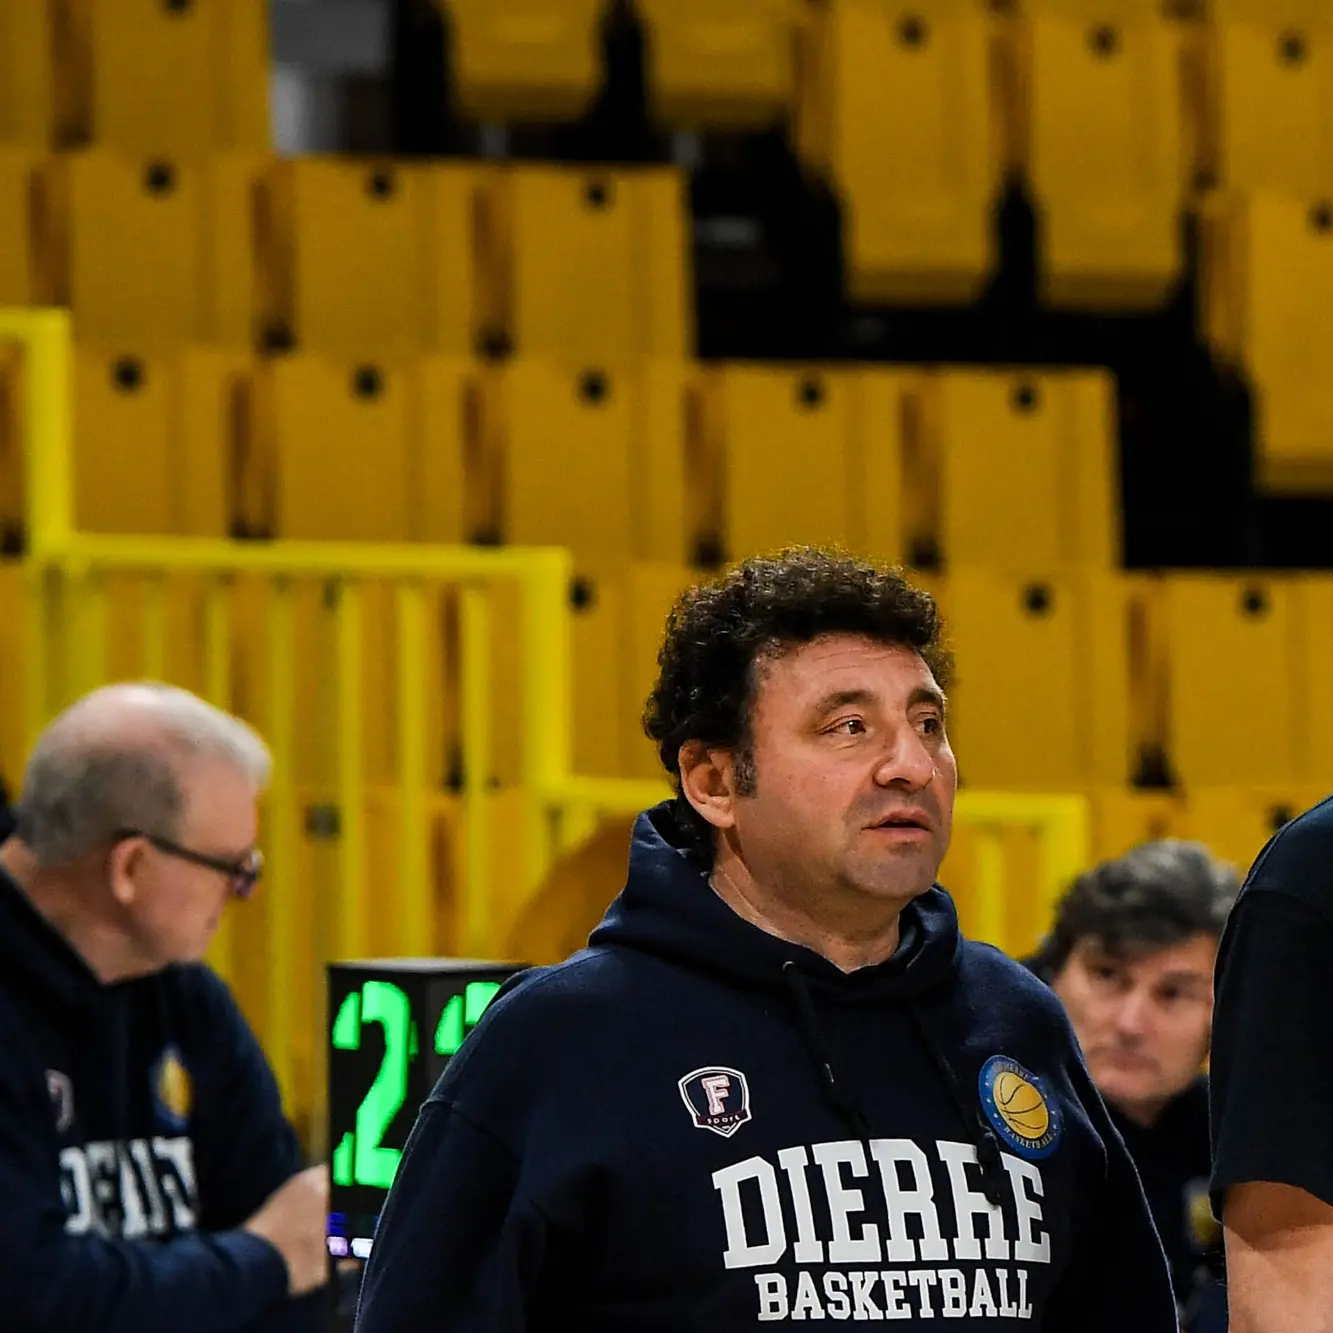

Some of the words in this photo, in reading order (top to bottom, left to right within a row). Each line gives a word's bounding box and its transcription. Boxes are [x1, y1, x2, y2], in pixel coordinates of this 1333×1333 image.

[333, 980, 502, 1187] 2
[701, 1074, 731, 1116] F
[711, 1138, 1051, 1269] DIERRE
[754, 1269, 1032, 1321] BASKETBALL
